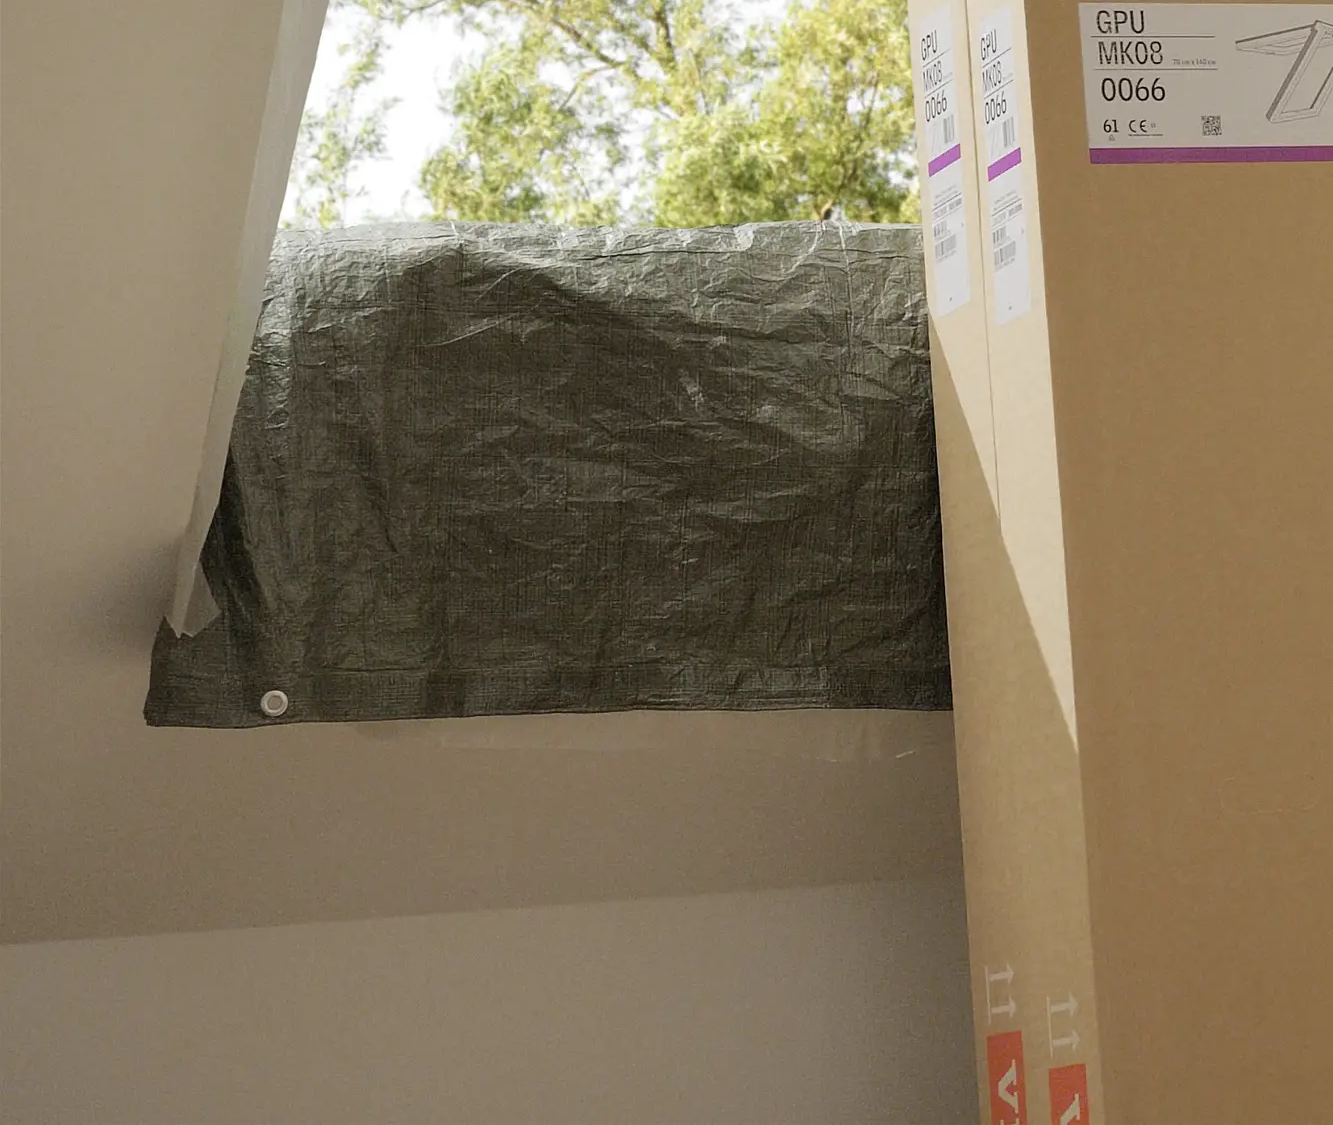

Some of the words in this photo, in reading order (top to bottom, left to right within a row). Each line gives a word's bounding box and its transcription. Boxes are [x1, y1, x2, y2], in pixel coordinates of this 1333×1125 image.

[1096, 10, 1146, 34] GPU
[921, 29, 937, 61] GPU
[980, 28, 997, 61] GPU
[1098, 41, 1163, 65] MK08
[1101, 78, 1166, 102] 0066
[925, 89, 947, 123] 0066
[985, 90, 1007, 125] 0066
[1103, 119, 1120, 133] 61
